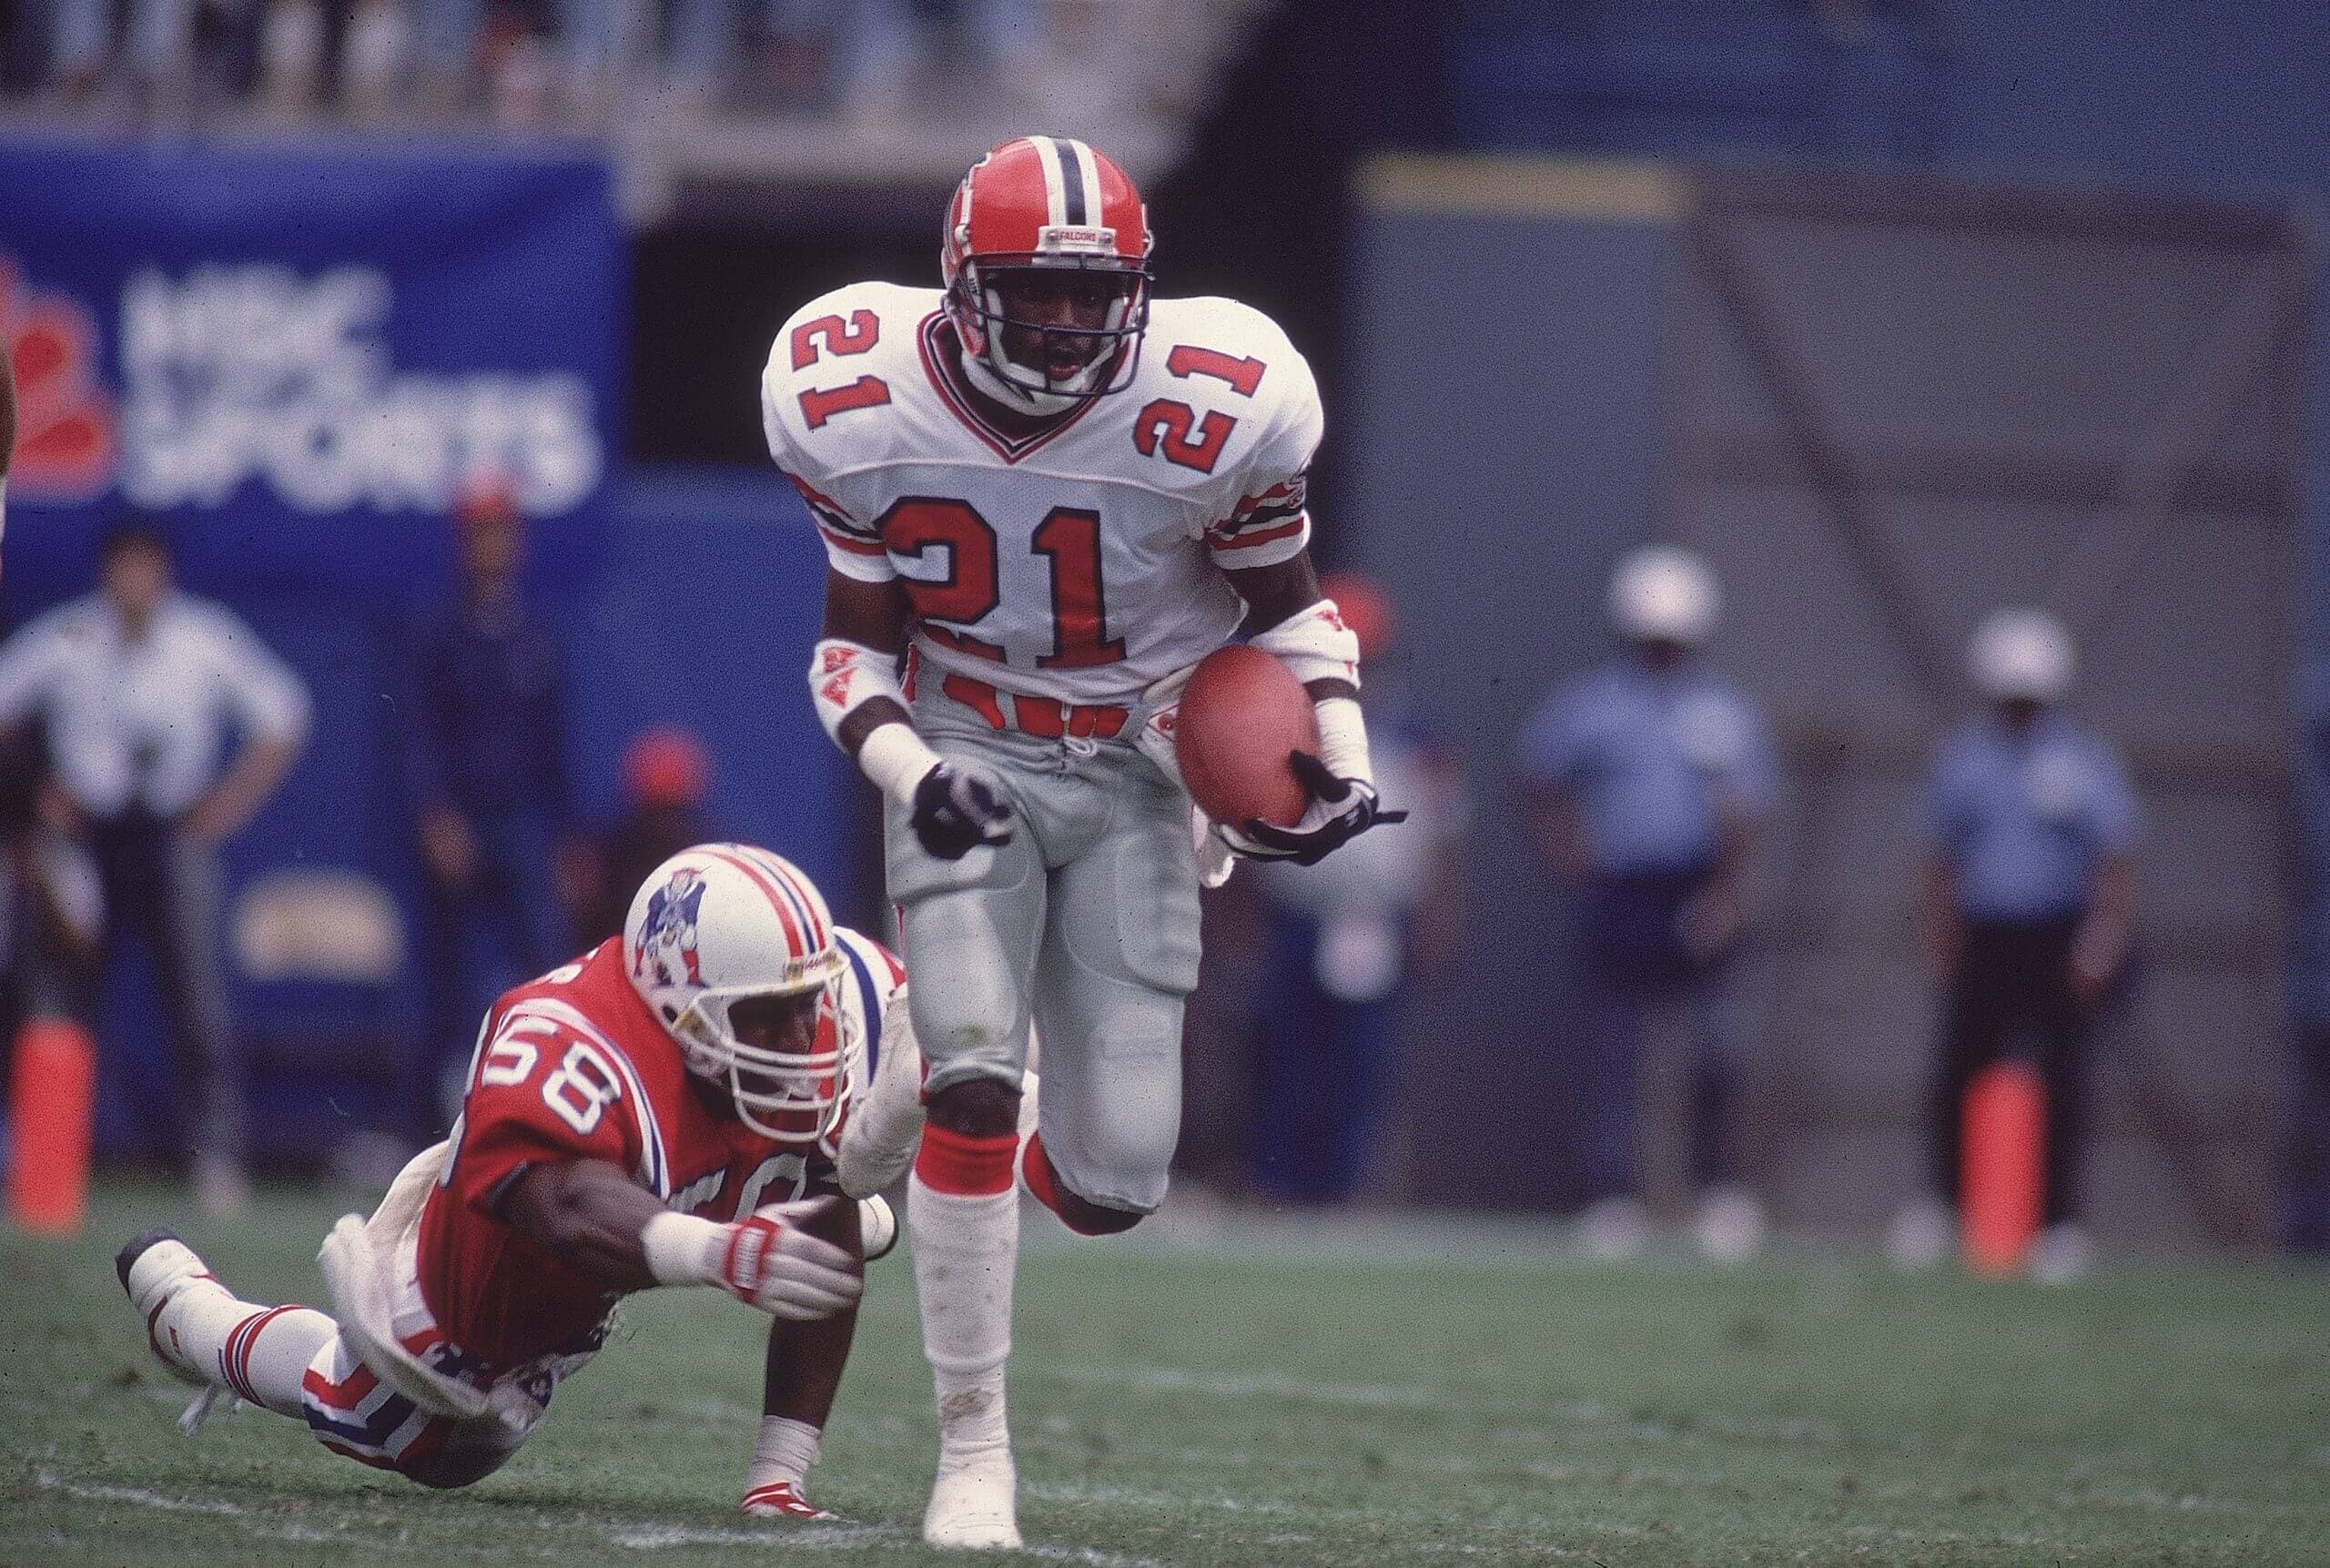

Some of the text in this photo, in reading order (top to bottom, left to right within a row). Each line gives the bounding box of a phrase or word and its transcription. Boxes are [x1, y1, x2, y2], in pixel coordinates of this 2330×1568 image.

[1059, 231, 1097, 242] FALCONS
[791, 309, 892, 430] 21
[1132, 345, 1267, 474] 21
[873, 495, 1128, 671] 21
[481, 1016, 622, 1135] 58
